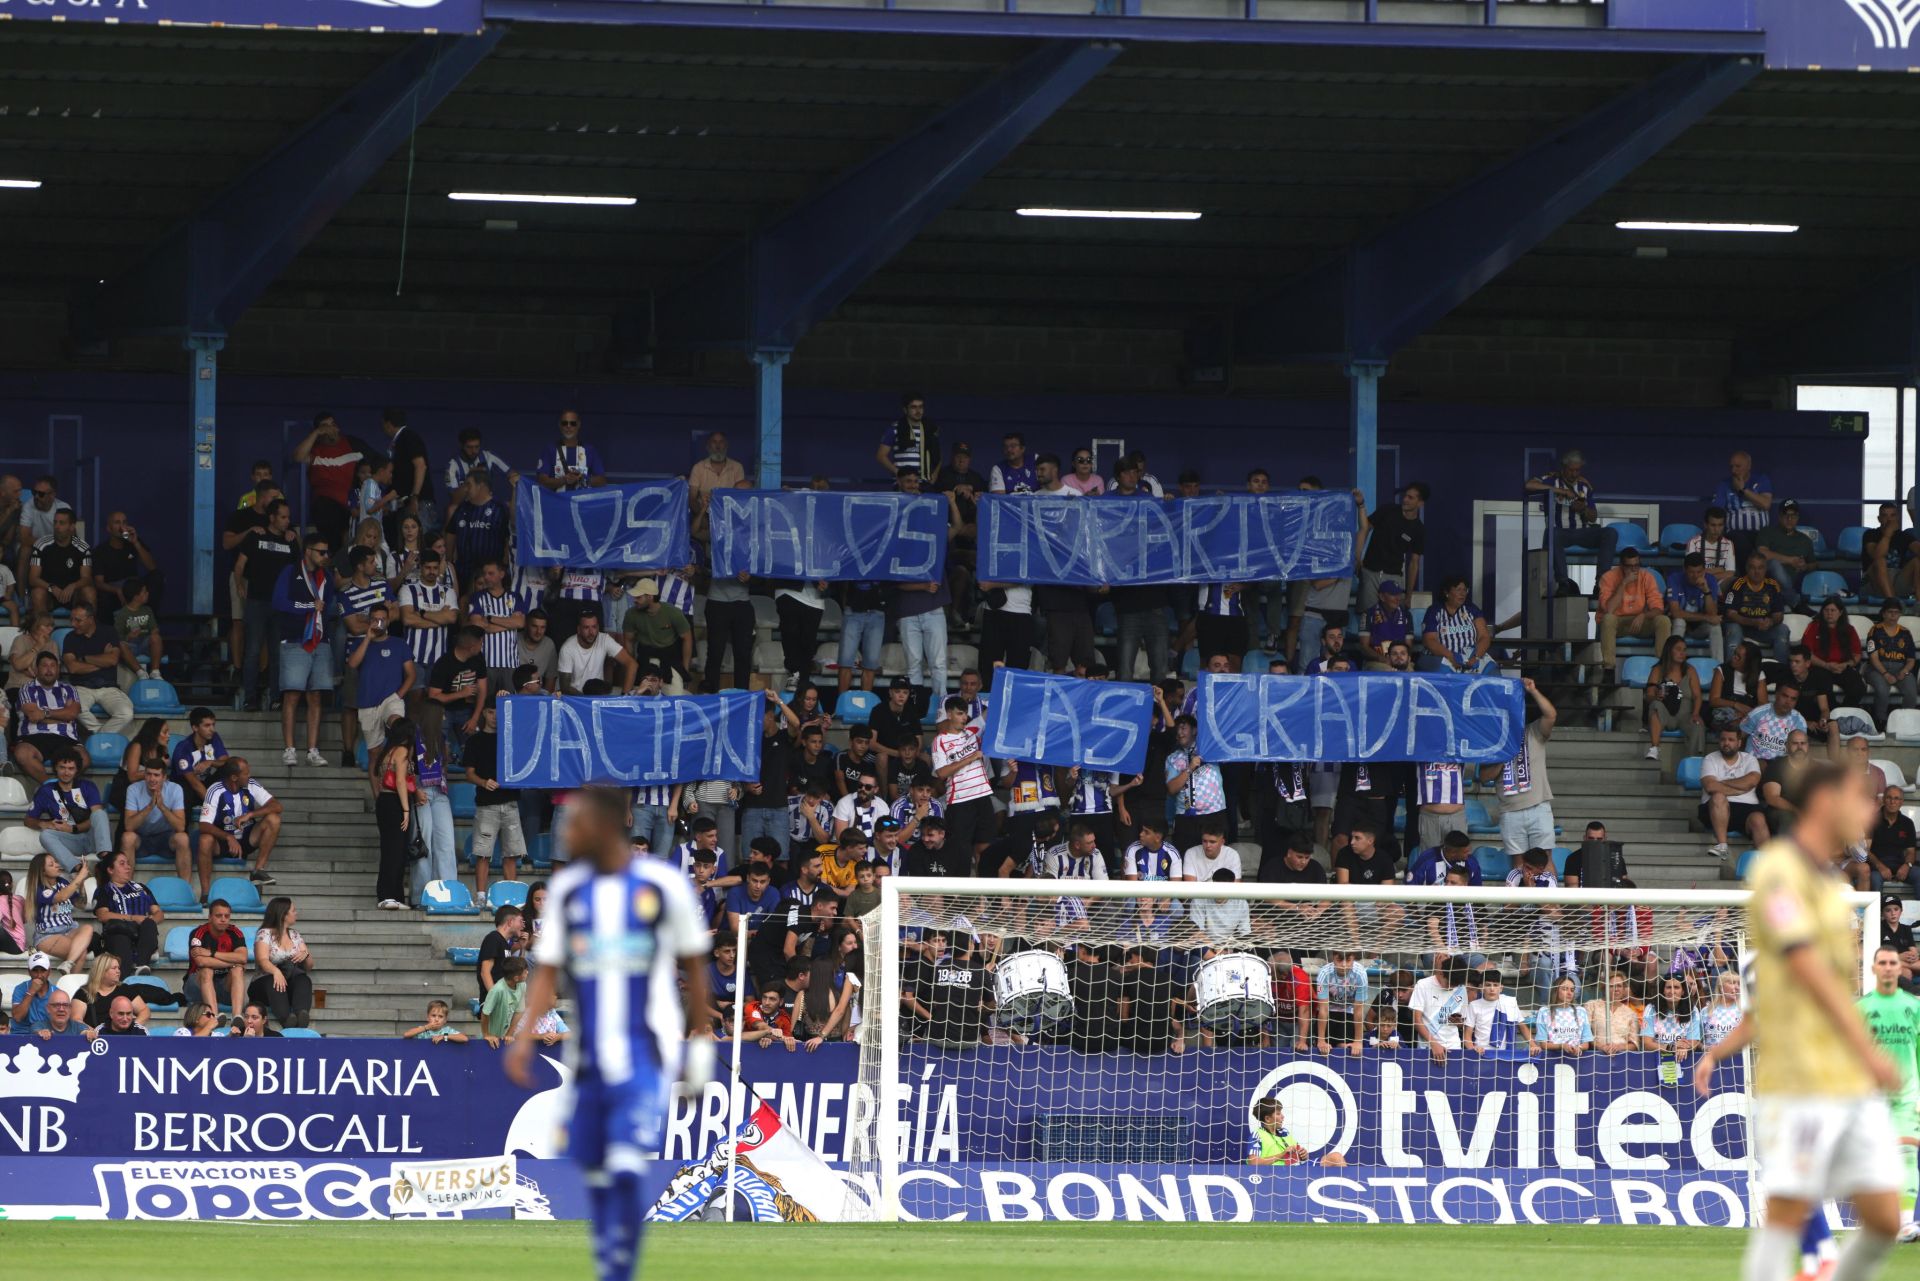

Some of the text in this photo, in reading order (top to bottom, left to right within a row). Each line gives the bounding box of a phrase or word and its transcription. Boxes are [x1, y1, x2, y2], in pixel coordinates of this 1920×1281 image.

[531, 485, 1354, 579] LOS MALOS HORARIOS
[503, 671, 1513, 782] VACIAN LAS GRADAS
[117, 1056, 440, 1097] INMOBILIARIA
[134, 1112, 424, 1154] BERROCALL
[131, 1167, 297, 1180] ELEVACIONES
[416, 1163, 511, 1192] VERSUS
[426, 1189, 503, 1204] E-LEARNING
